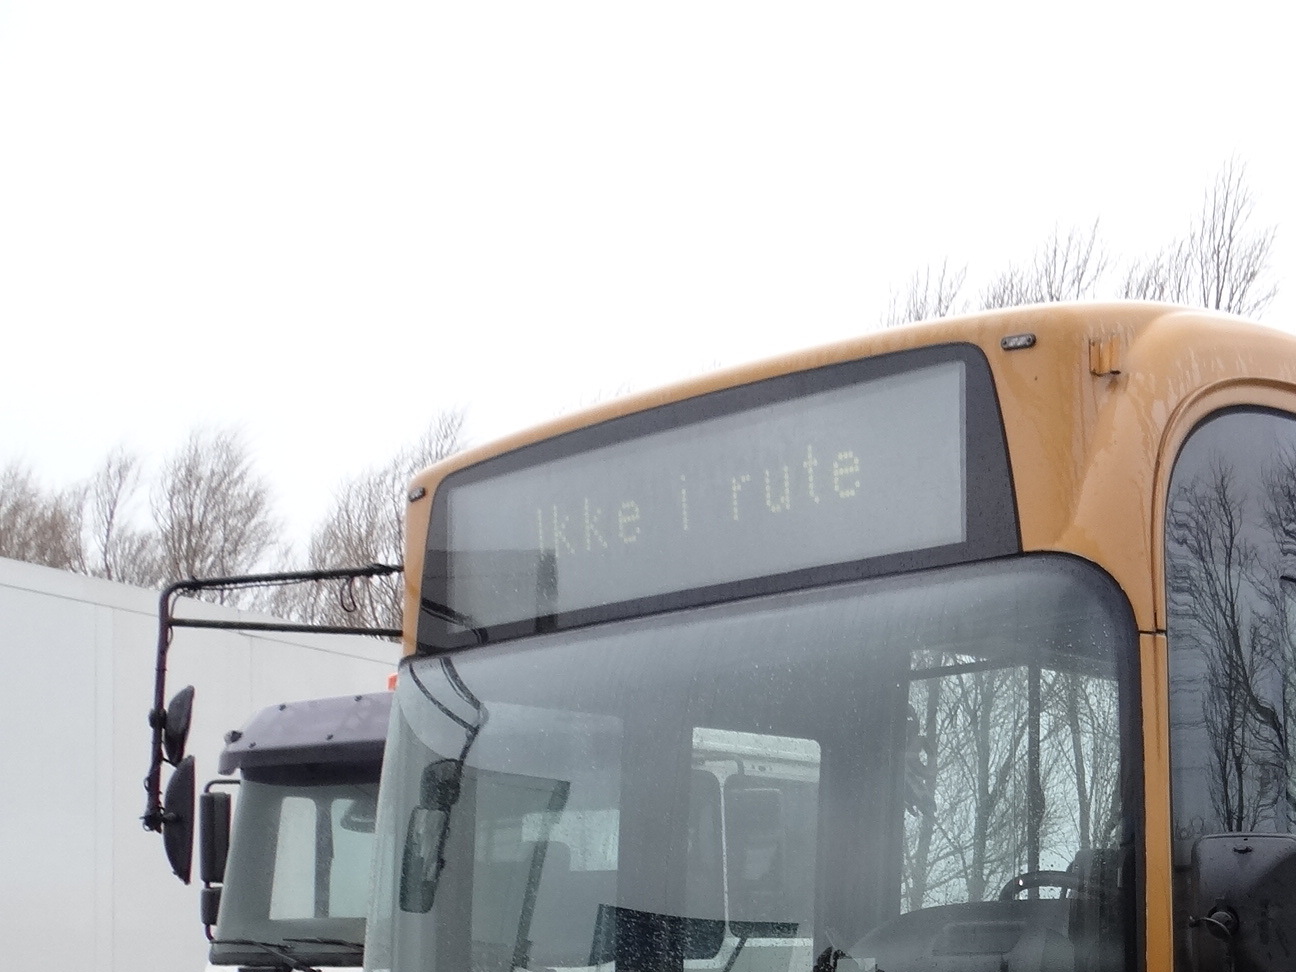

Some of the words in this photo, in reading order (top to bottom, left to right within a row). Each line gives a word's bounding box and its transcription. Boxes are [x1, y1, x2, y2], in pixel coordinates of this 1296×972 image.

[537, 498, 641, 560] Ikke
[680, 473, 690, 532] i
[731, 444, 861, 521] rute
